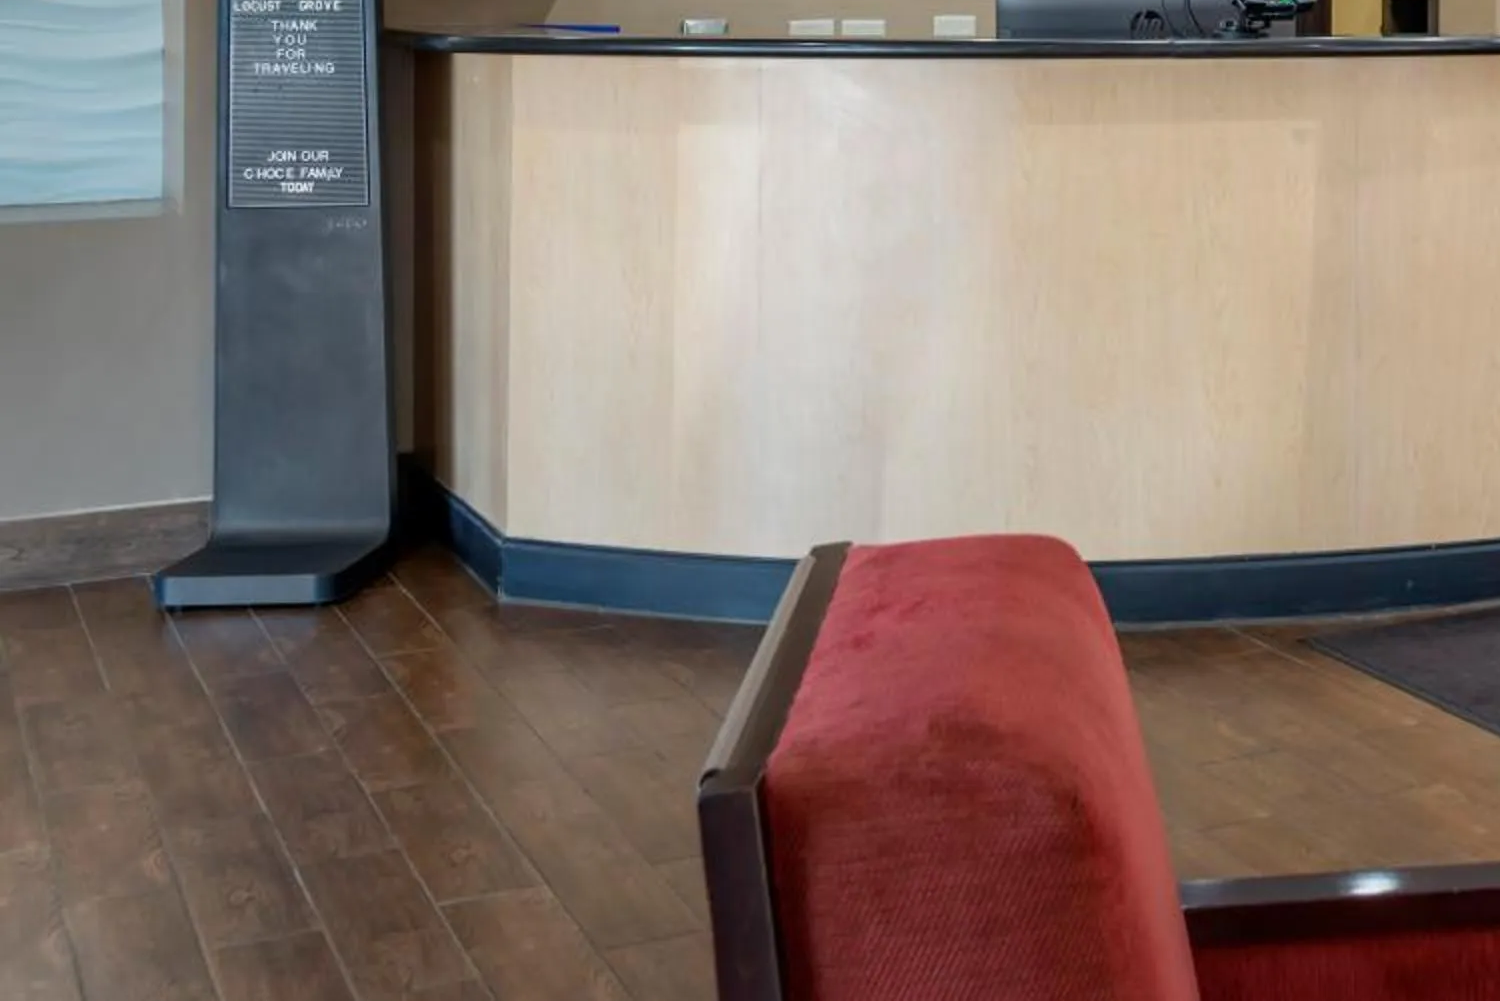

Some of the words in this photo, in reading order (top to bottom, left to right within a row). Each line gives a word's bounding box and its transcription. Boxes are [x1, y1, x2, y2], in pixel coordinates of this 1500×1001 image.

[233, 0, 281, 12] LOCUST
[299, 0, 342, 11] GROVE
[271, 20, 318, 31] THANK
[272, 34, 308, 45] YOU
[276, 48, 306, 59] FOR
[254, 62, 336, 75] TRAVELING
[267, 150, 297, 162] JOIN
[301, 150, 329, 162] OUR
[281, 182, 315, 193] TODAY
